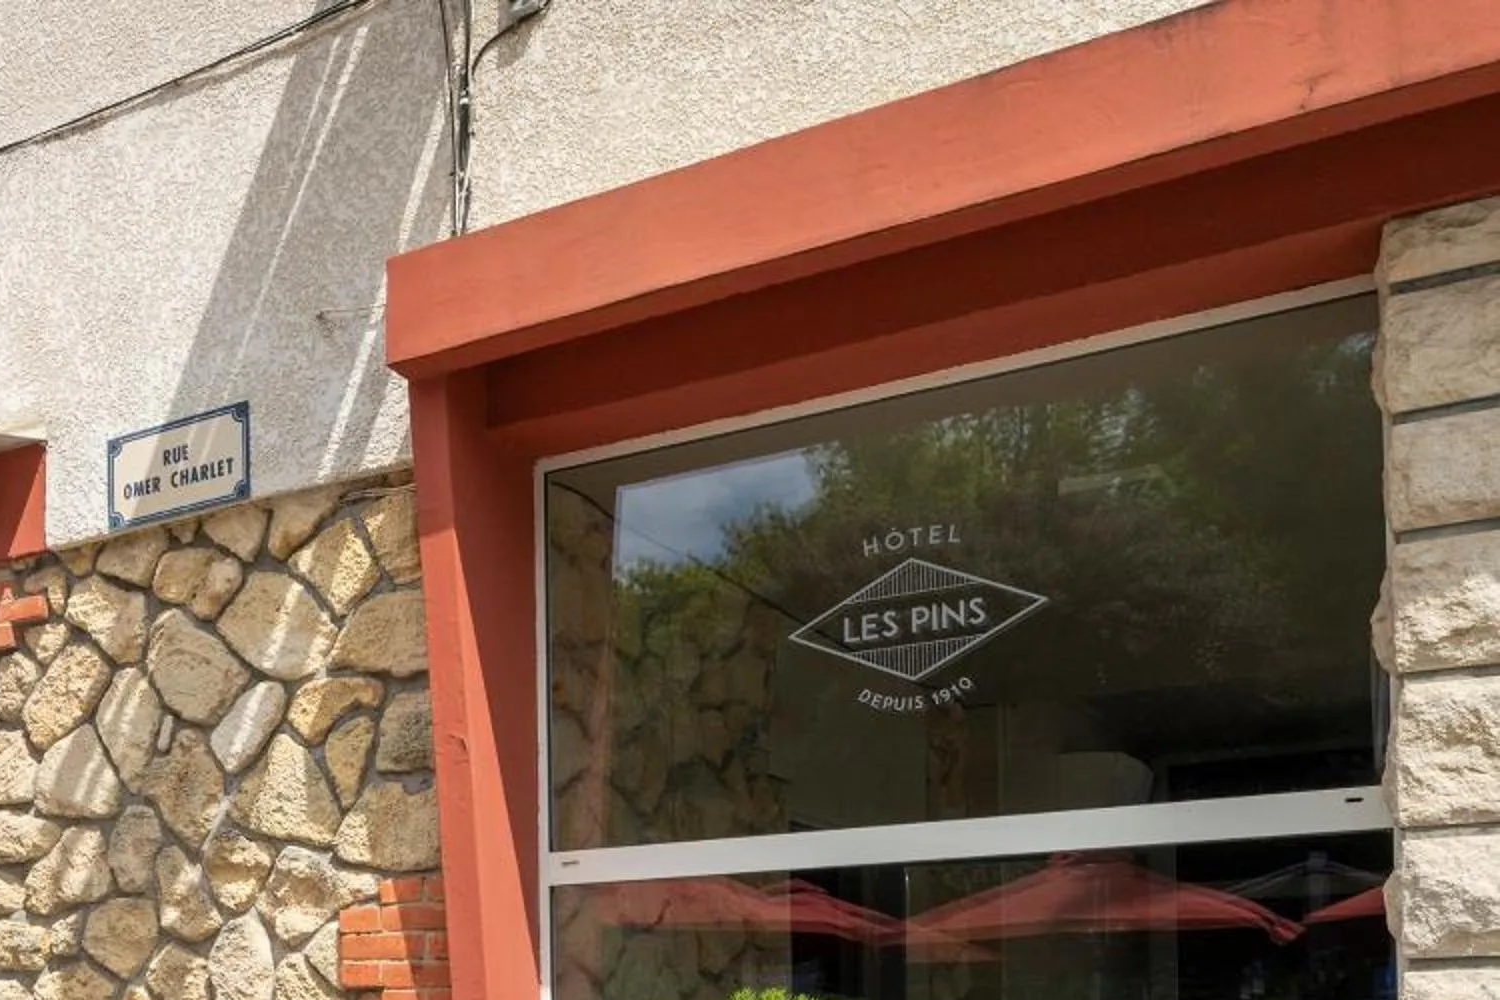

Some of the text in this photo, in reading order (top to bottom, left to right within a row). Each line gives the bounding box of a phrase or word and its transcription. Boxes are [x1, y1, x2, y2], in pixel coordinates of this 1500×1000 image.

[163, 443, 189, 467] RUE
[123, 457, 235, 499] OMER CHARLET
[862, 524, 961, 558] HÔTEL
[842, 597, 988, 644] LES PINS
[858, 677, 972, 712] DEPUIS 1910
